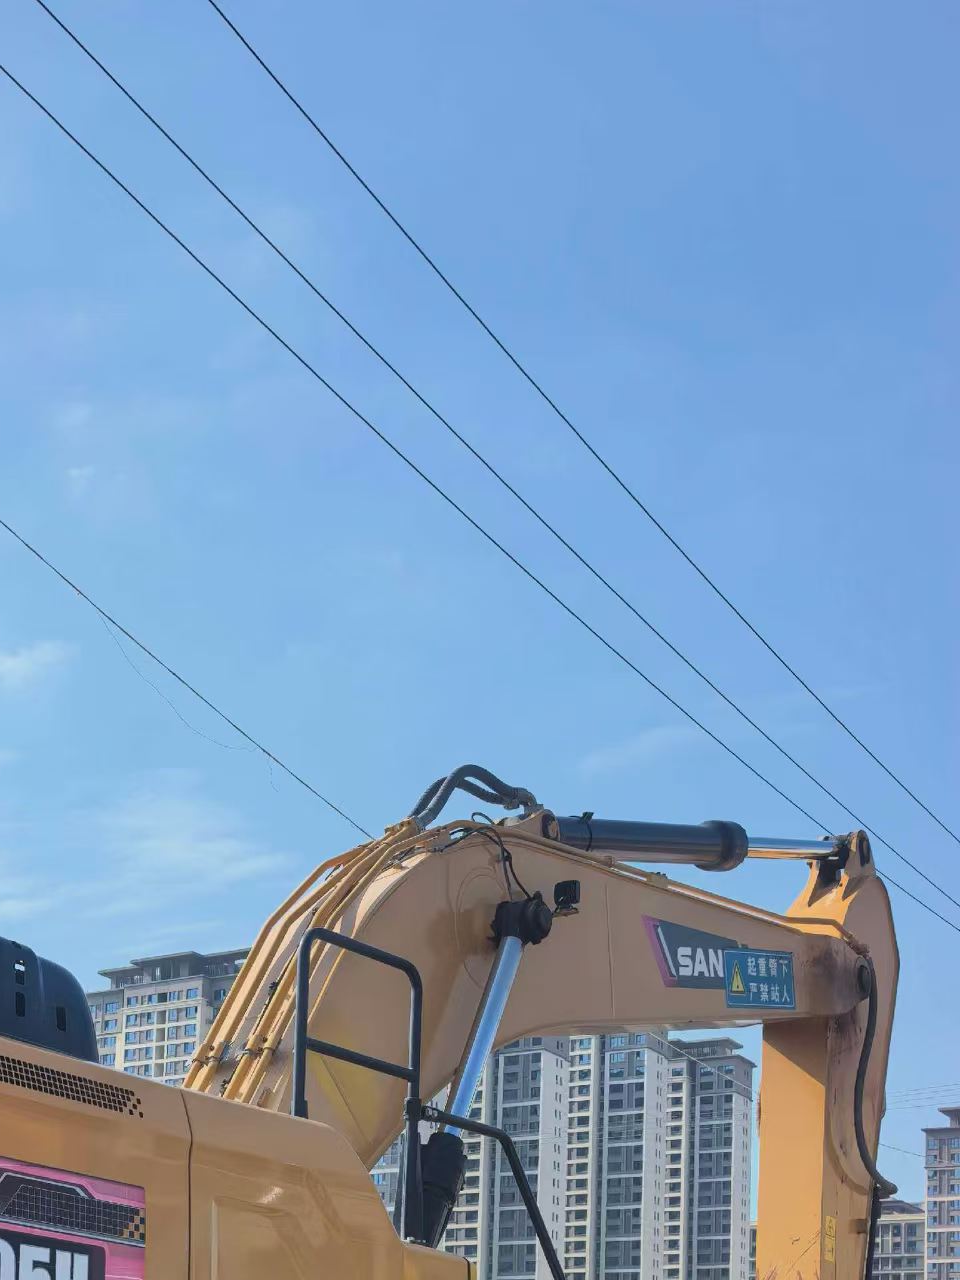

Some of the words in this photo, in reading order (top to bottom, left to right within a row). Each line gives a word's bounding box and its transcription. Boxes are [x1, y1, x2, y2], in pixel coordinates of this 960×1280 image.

[677, 946, 724, 978] SAN
[747, 956, 788, 978] 起重臂下
[749, 982, 790, 1003] 严禁站人
